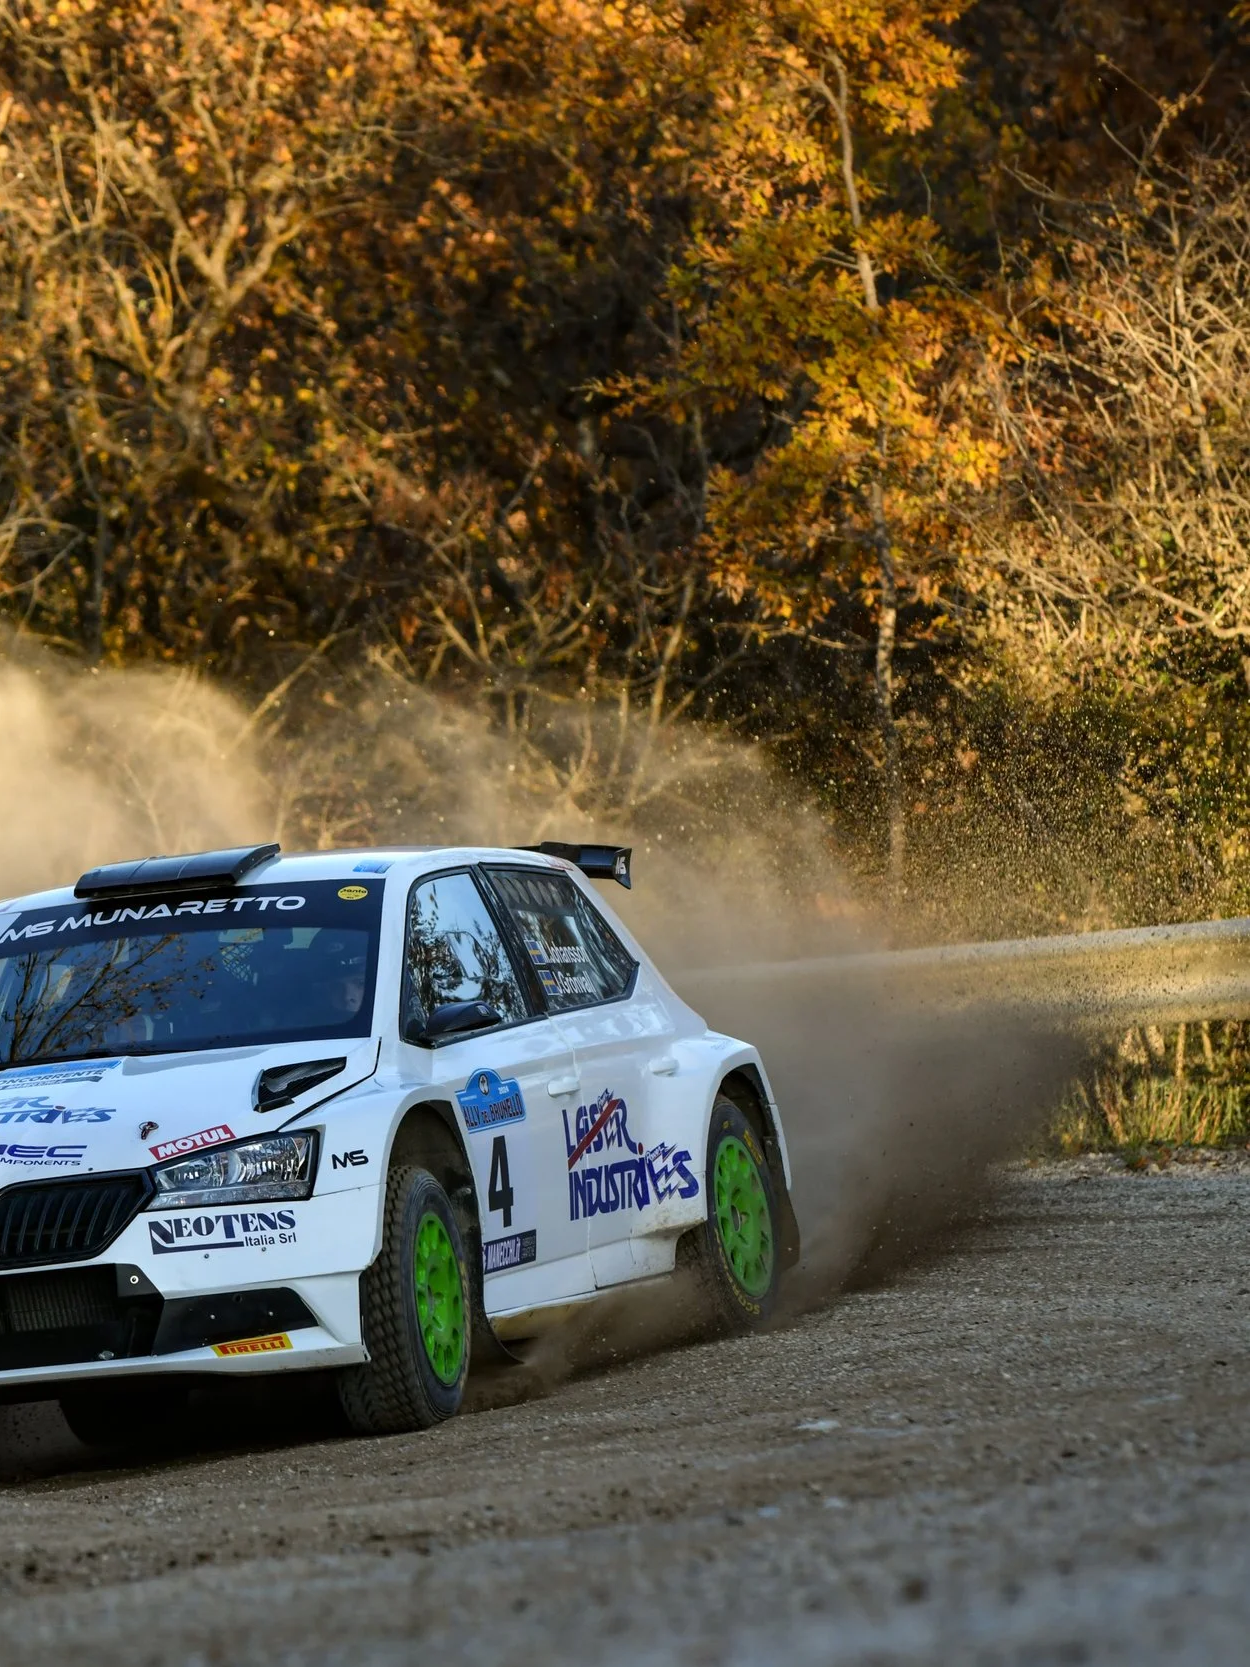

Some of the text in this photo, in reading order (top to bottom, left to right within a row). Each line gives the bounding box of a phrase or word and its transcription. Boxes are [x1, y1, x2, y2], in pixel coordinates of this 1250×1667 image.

[57, 895, 306, 932] MUNARETTO
[158, 1127, 231, 1159] MOTUL
[332, 1149, 370, 1169] MS
[488, 1135, 514, 1228] 4
[148, 1209, 297, 1245] NEOTENS
[245, 1232, 297, 1247] Italia Srl
[217, 1335, 287, 1356] PIRELLI
